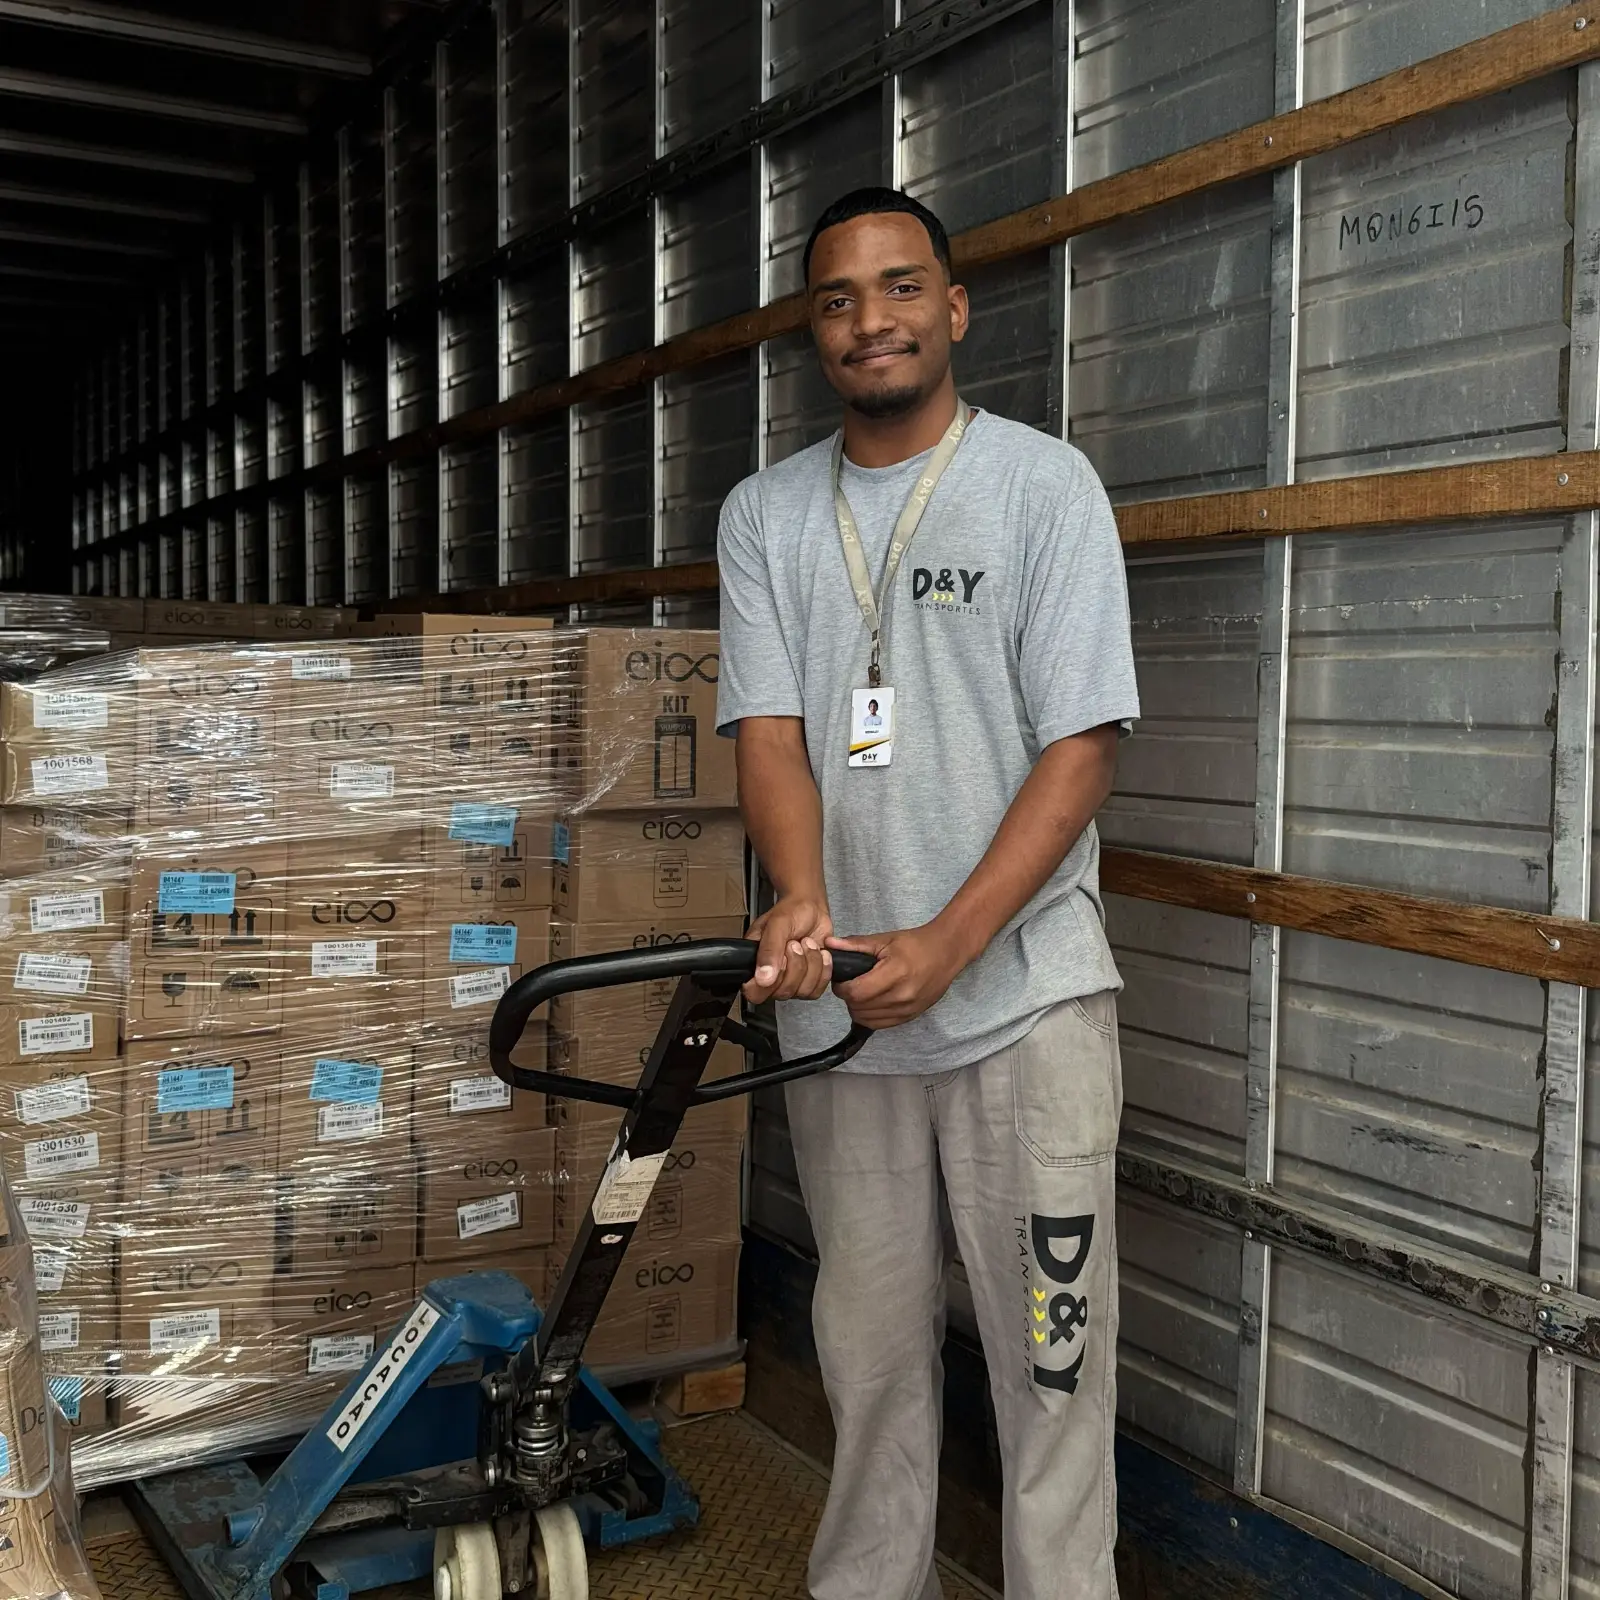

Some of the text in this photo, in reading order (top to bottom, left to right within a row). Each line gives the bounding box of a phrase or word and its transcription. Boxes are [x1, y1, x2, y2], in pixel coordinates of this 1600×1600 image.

[912, 567, 986, 604] D&Y
[662, 695, 690, 714] KIT
[43, 755, 93, 770] 1001568
[862, 753, 878, 761] D&Y
[37, 1135, 86, 1152] 1001530
[31, 1200, 78, 1213] 1001530
[1031, 1212, 1096, 1397] D&Y
